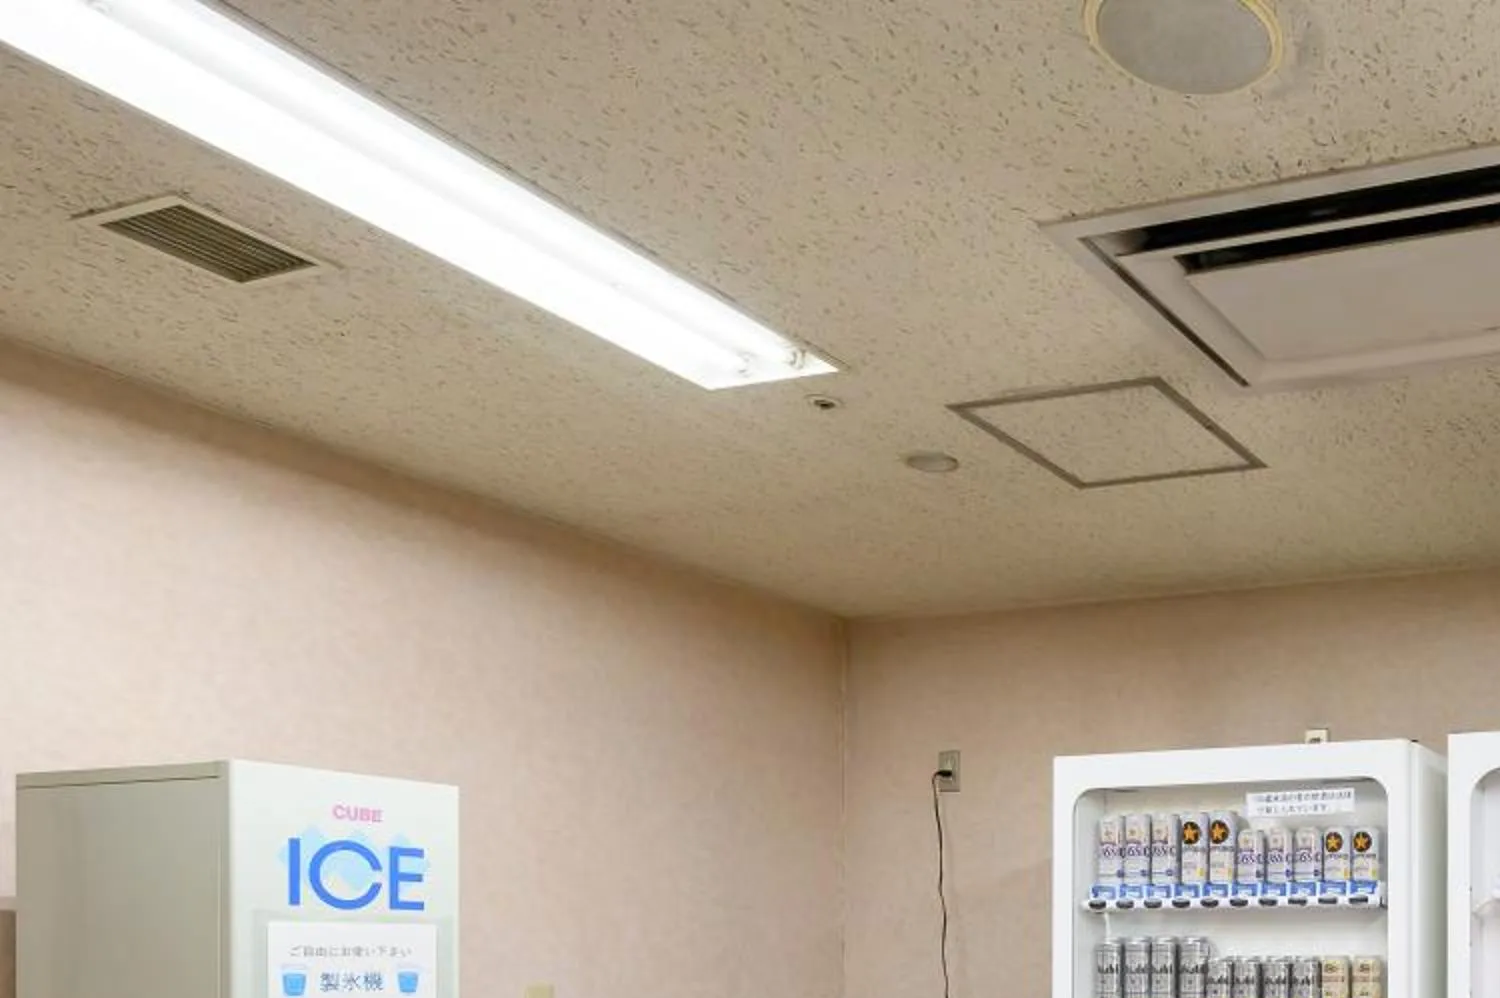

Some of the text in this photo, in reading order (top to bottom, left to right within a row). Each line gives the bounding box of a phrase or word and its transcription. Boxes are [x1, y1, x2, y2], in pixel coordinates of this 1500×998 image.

[332, 804, 384, 822] CUBE
[288, 837, 425, 910] ICE
[319, 971, 384, 993] 製氷機
